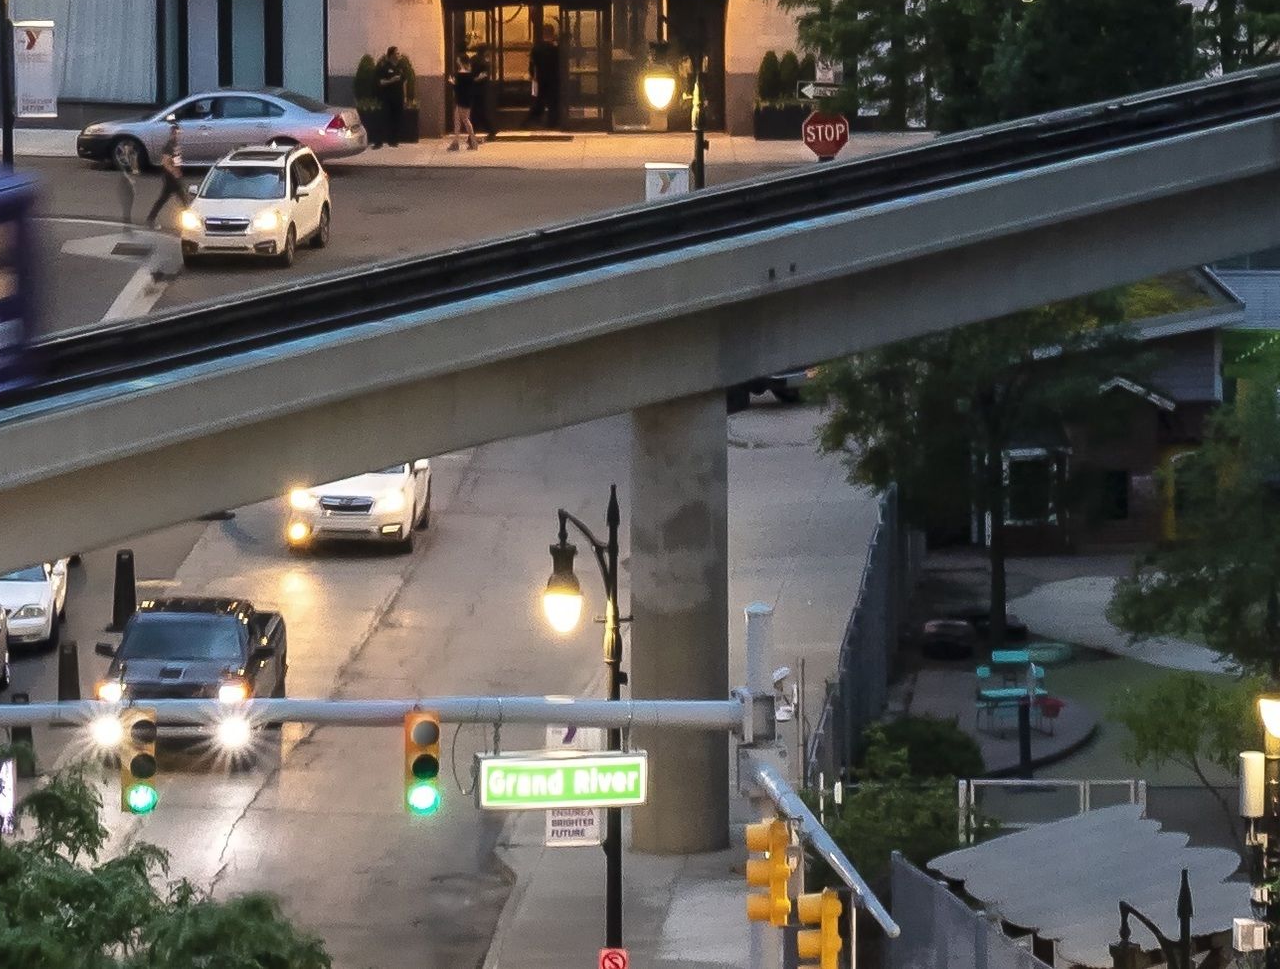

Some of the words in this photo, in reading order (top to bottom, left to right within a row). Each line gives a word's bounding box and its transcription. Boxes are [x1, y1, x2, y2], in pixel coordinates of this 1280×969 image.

[806, 123, 846, 142] STOP
[488, 768, 564, 797] Grand
[573, 766, 639, 796] River
[551, 818, 594, 828] BRIGHTER
[551, 828, 586, 838] FUTURE
